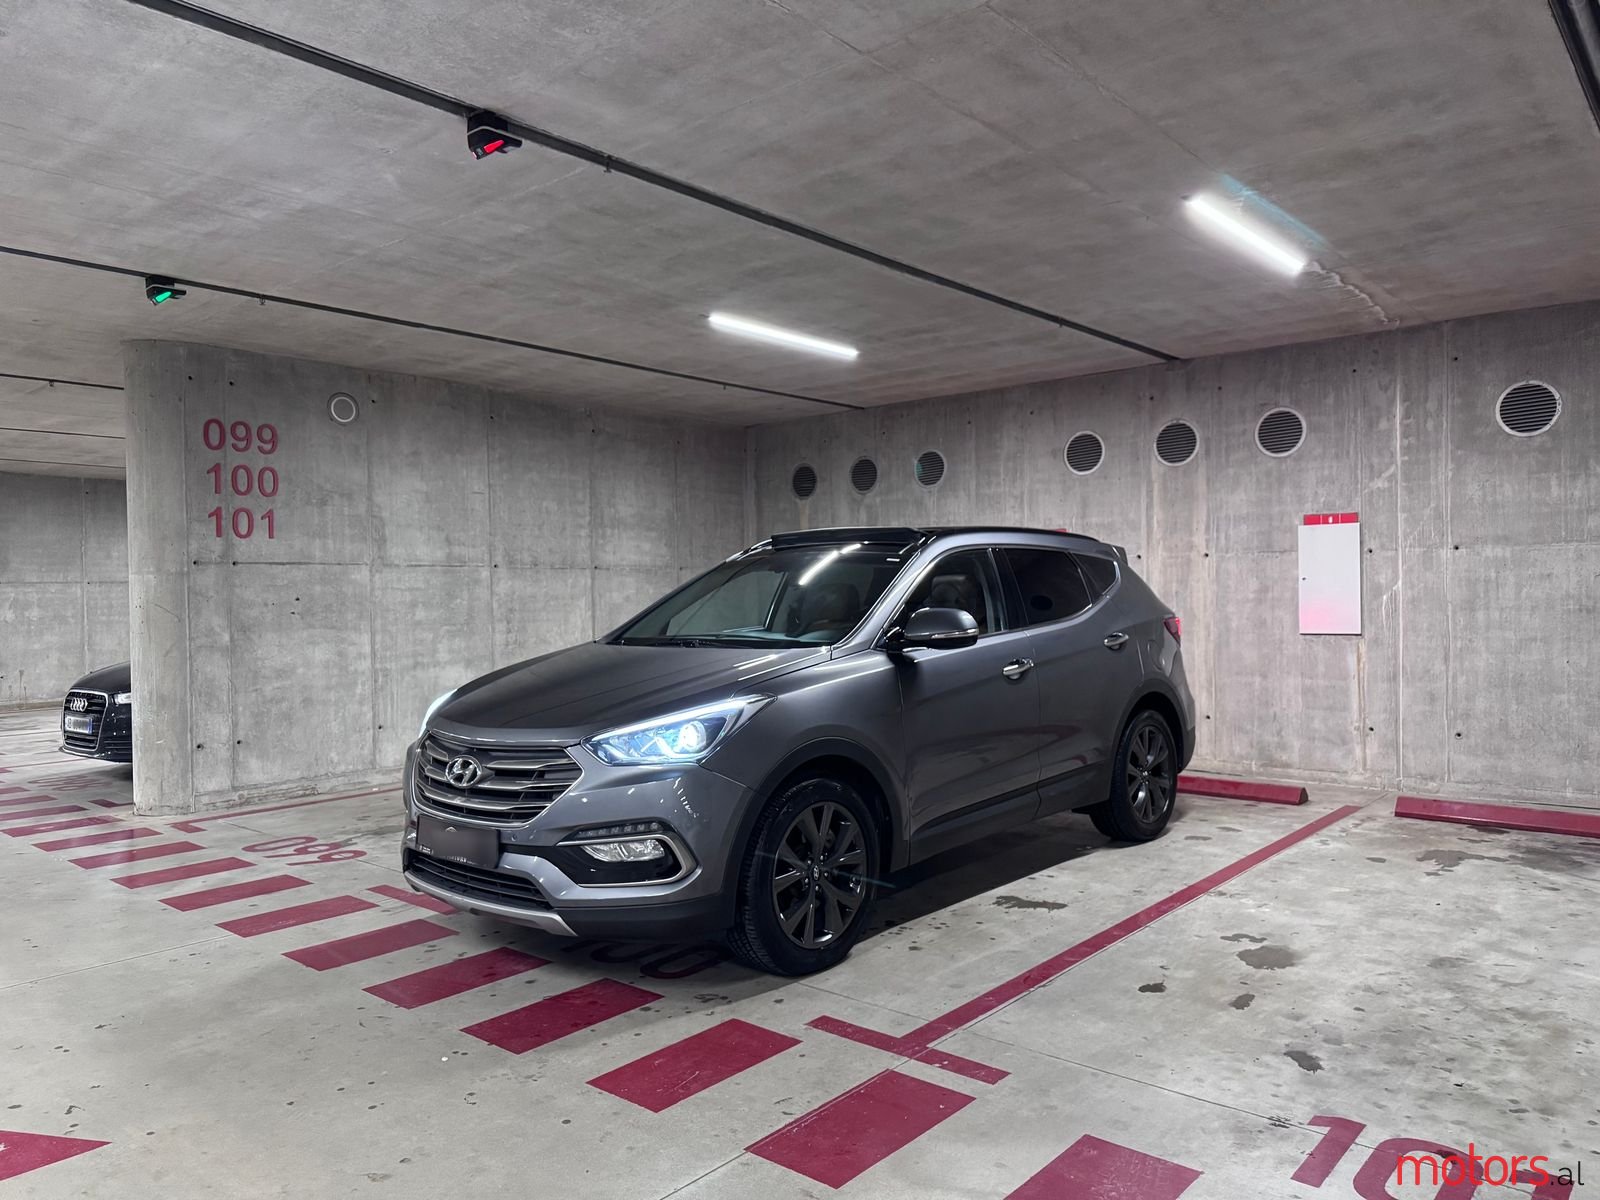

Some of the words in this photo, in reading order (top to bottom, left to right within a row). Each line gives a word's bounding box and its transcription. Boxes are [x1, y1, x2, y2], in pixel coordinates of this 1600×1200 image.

[203, 418, 279, 455] 099
[206, 462, 279, 498] 100
[208, 506, 275, 540] 101
[241, 836, 367, 866] 099
